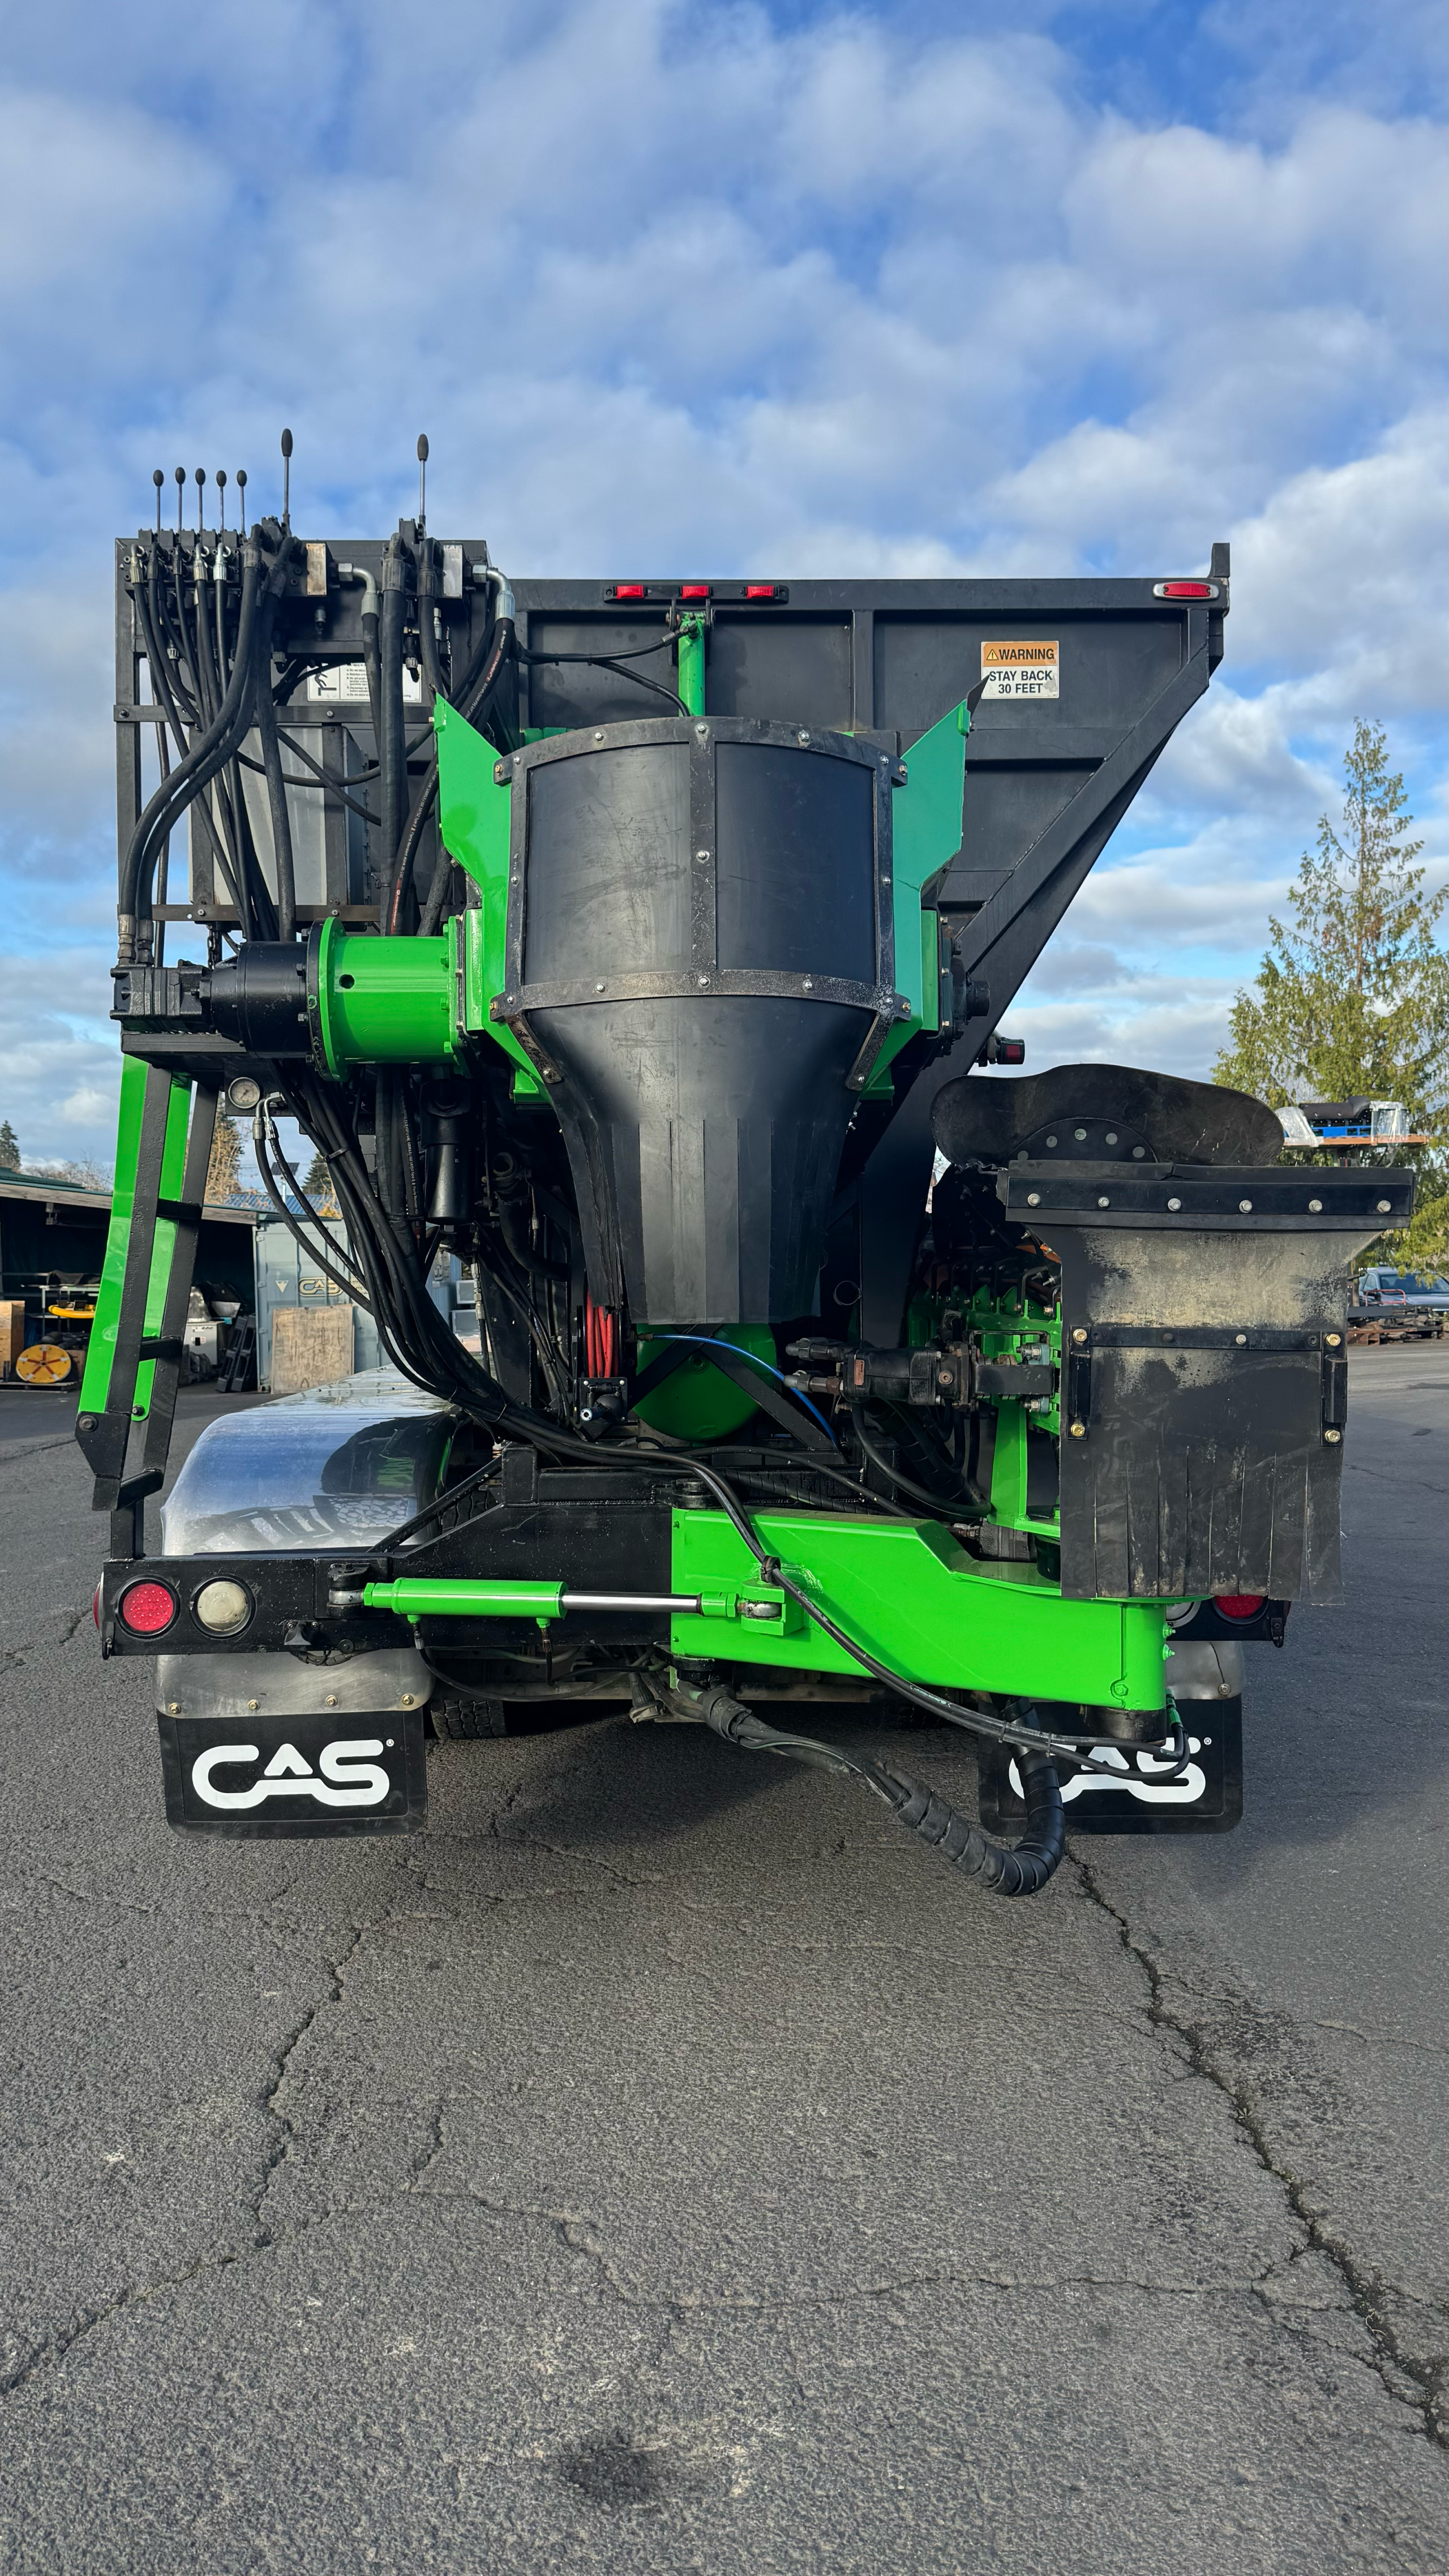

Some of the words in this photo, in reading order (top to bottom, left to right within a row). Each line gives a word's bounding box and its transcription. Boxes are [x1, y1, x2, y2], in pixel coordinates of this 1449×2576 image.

[998, 648, 1054, 661] WARNING
[989, 670, 1017, 681] STAY
[1021, 670, 1053, 681] BACK
[998, 683, 1011, 694] 30
[1015, 683, 1043, 693] FEET
[299, 1279, 340, 1295] CAS
[192, 1739, 390, 1809] CAS
